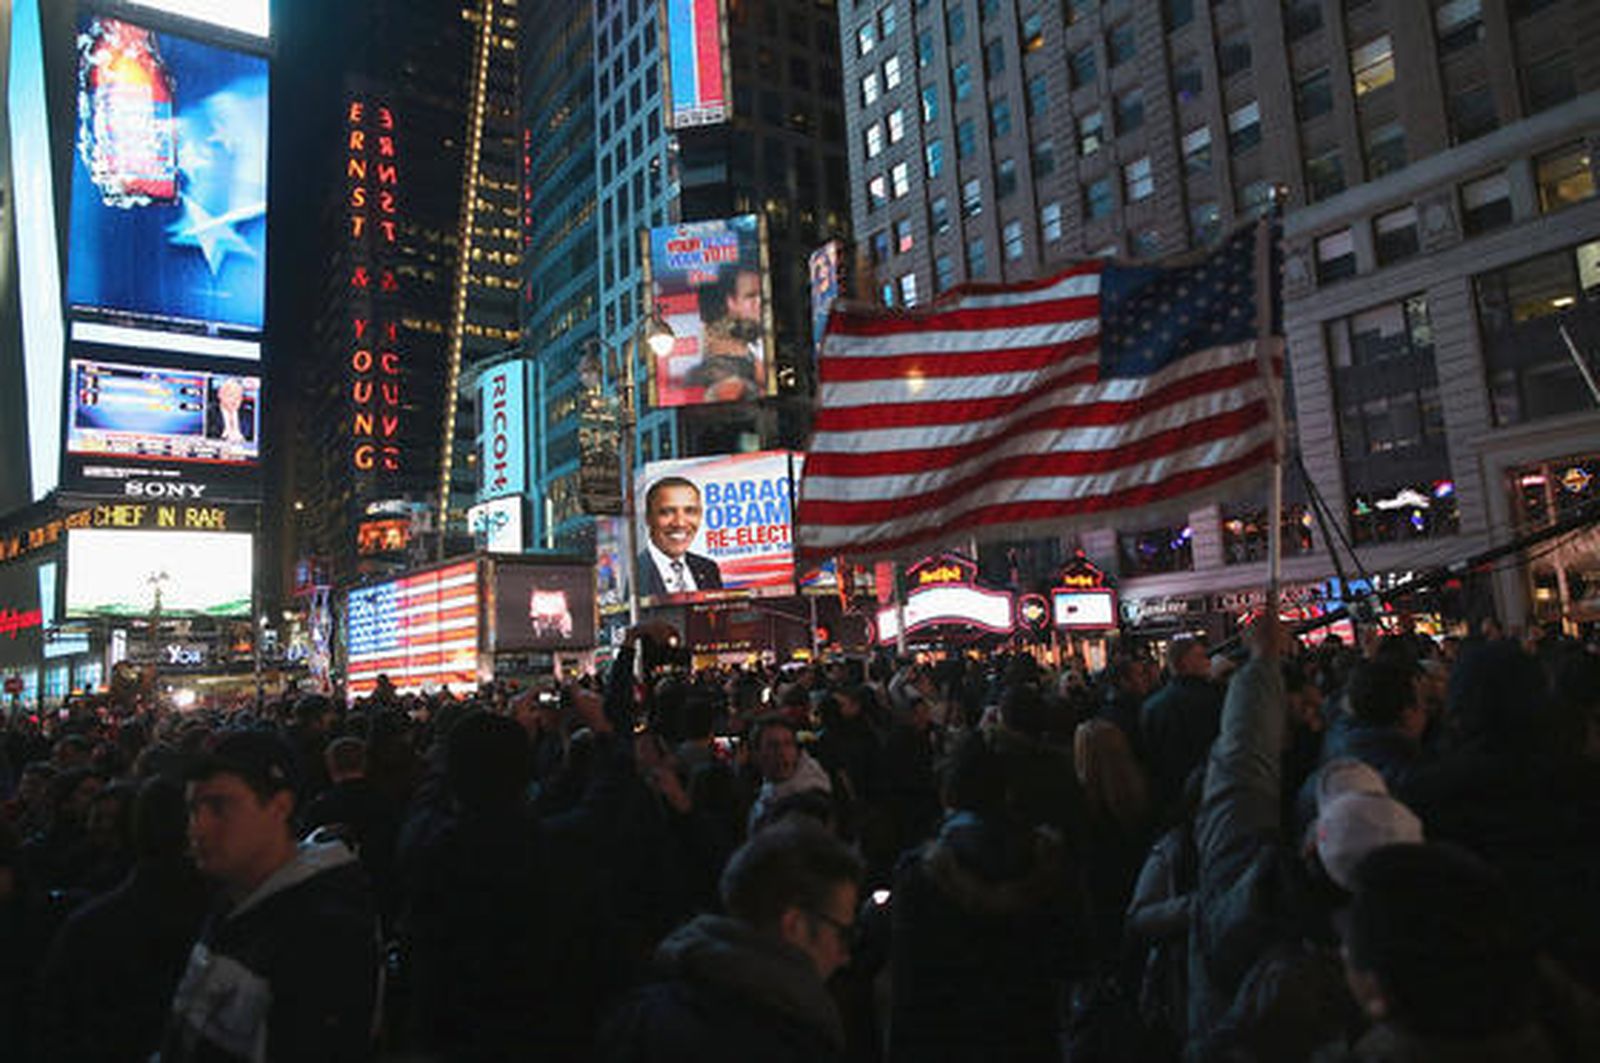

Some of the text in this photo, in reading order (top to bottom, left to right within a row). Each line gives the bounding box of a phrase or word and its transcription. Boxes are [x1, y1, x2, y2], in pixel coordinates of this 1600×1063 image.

[348, 101, 374, 470] ERNST & YOUNG
[492, 374, 508, 484] RICOH
[125, 480, 206, 499] SONY
[704, 476, 792, 505] BARAC
[705, 500, 791, 529] OBAM
[705, 524, 790, 549] RE-ELECT
